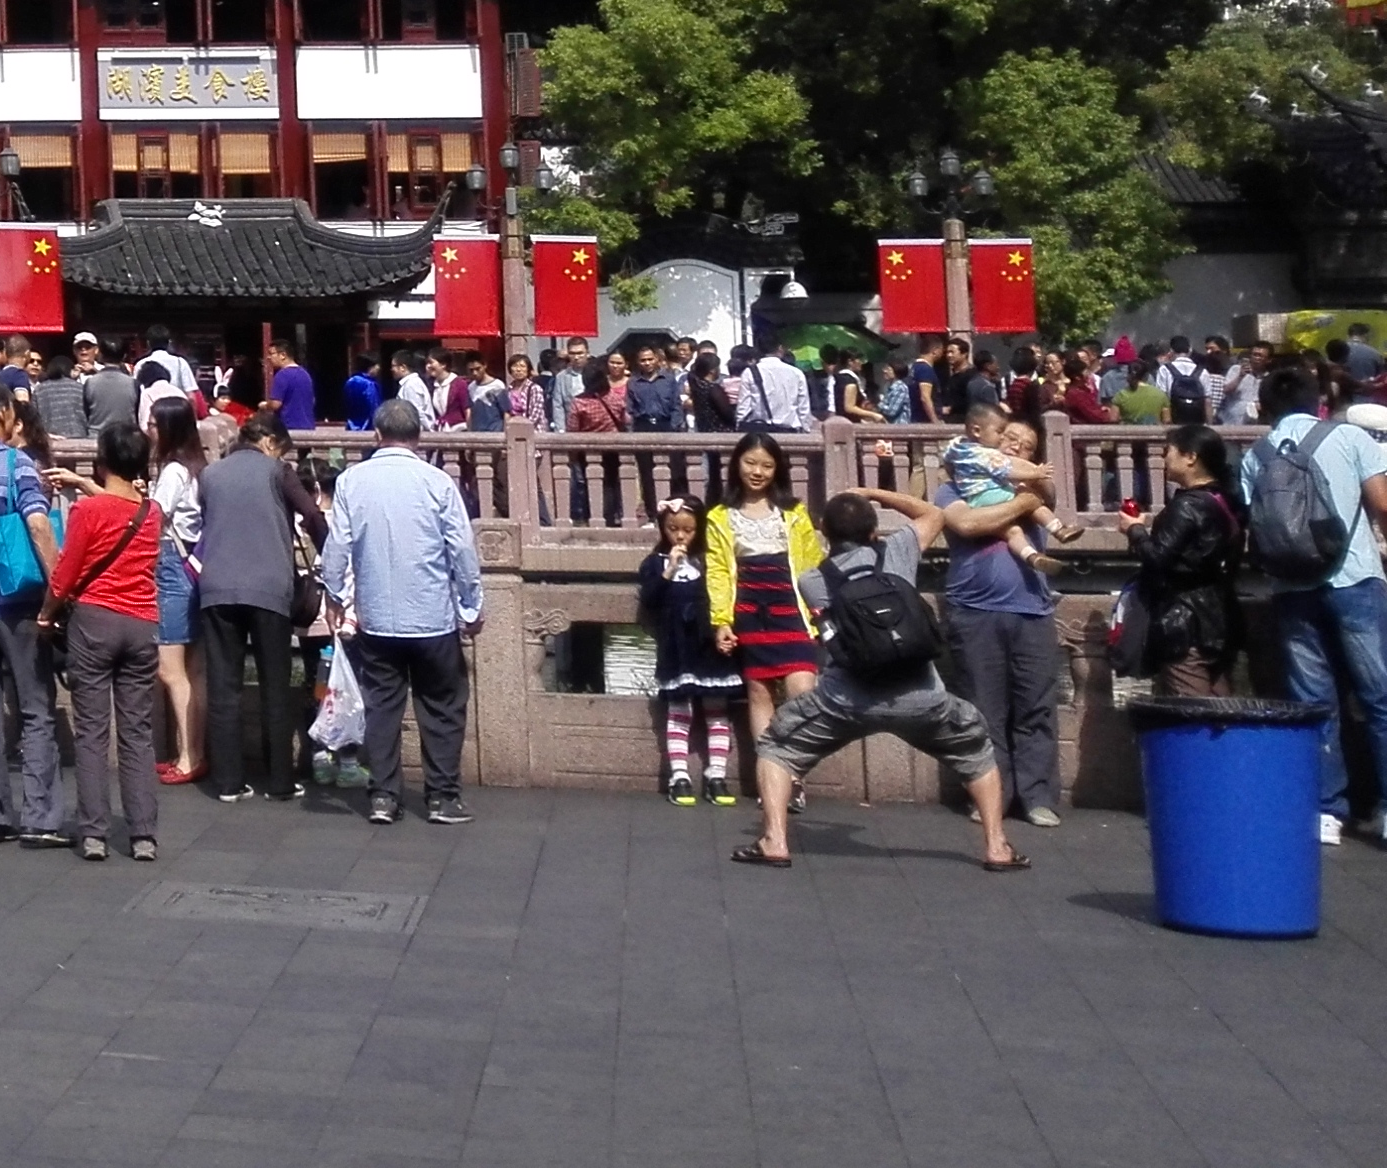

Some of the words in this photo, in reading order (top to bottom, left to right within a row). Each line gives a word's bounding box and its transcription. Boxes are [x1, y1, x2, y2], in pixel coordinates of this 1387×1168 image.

[106, 63, 271, 105] 湖濱美食樓
